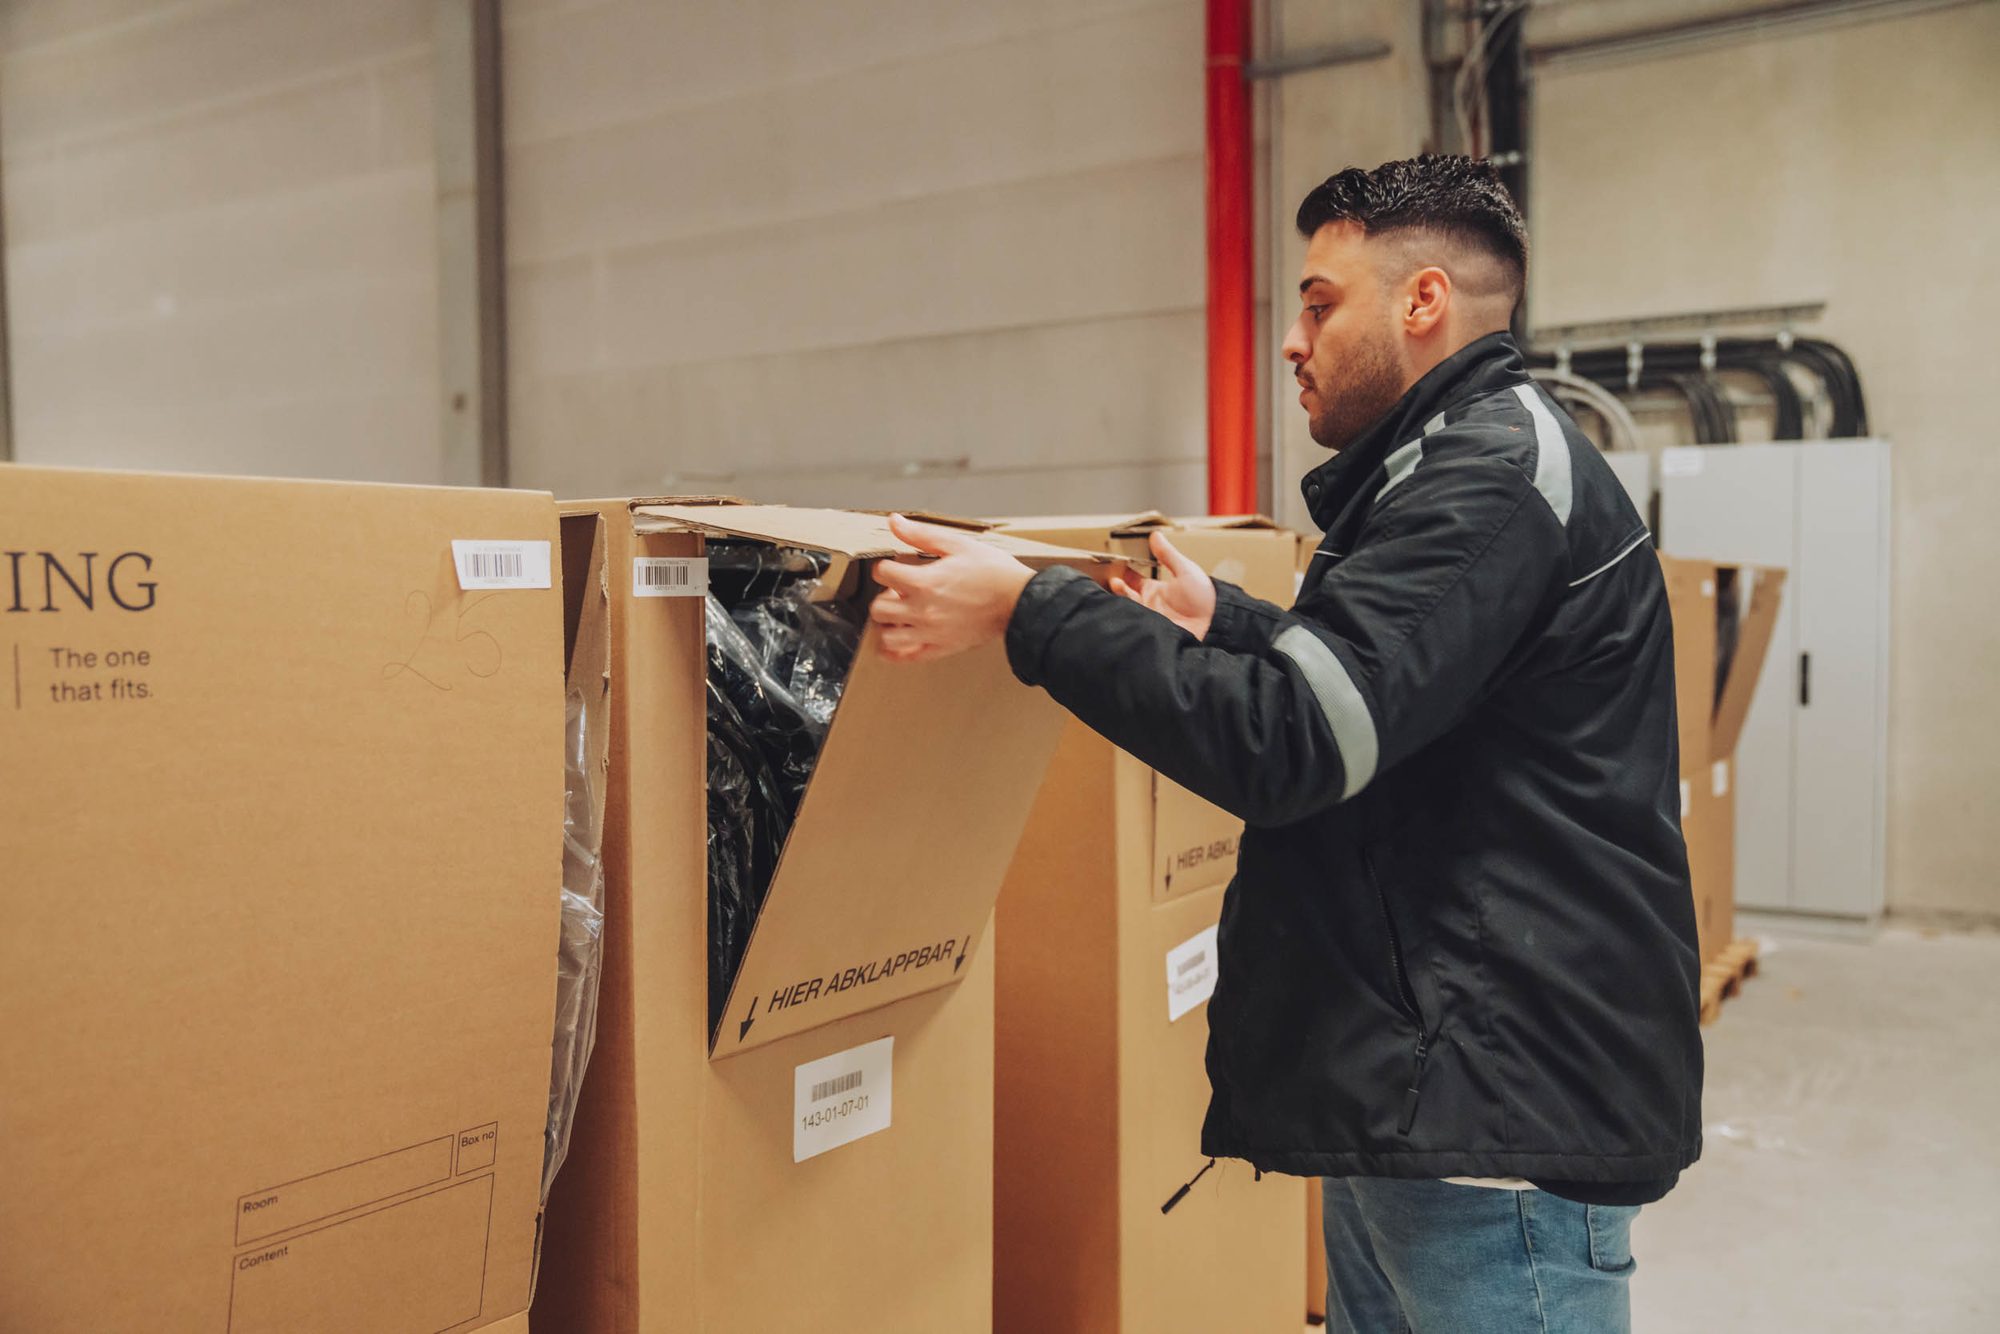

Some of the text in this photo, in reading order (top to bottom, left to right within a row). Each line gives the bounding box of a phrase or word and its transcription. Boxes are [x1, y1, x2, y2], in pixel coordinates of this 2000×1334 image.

[3, 551, 159, 612] ING
[49, 647, 151, 669] The one
[50, 678, 154, 703] that fits.
[1176, 845, 1204, 870] HIER
[767, 939, 956, 1014] HIER ABKLAPPBAR
[801, 1094, 870, 1132] 143-01-07-01
[460, 1130, 495, 1148] Box no
[242, 1194, 279, 1214] Room
[238, 1245, 289, 1271] Content
